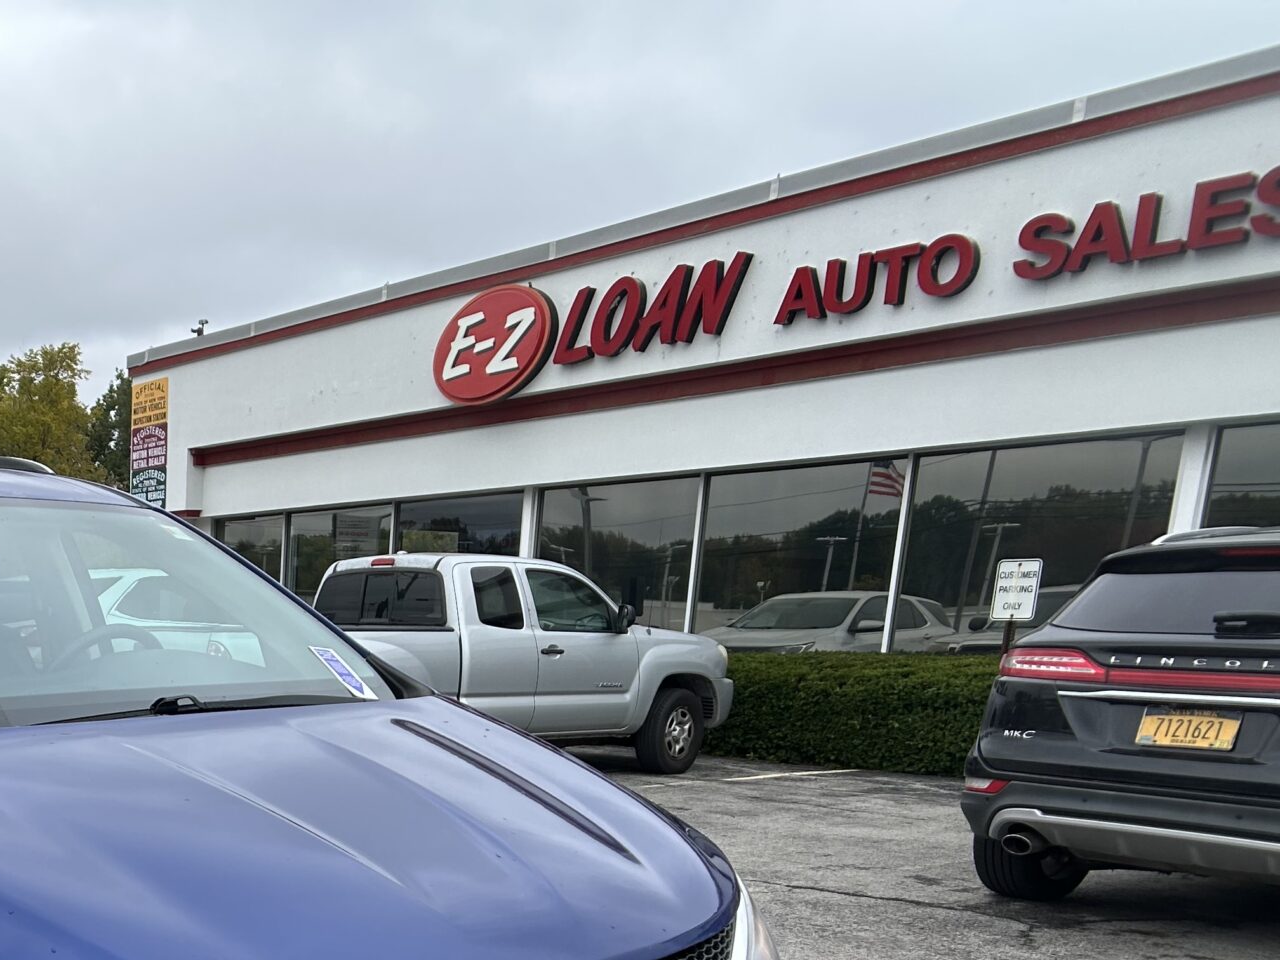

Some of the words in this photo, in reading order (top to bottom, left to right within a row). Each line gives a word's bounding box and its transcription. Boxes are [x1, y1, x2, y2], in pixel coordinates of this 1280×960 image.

[442, 307, 536, 381] E-Z
[552, 250, 753, 366] LOAN
[773, 233, 982, 326] AUTO
[135, 382, 165, 399] OFFICIAL
[148, 400, 167, 412] VEHICLE
[133, 425, 166, 445] REGISTERED
[148, 455, 165, 467] DEALER
[132, 469, 166, 486] REGISTERED
[999, 571, 1038, 580] CUSOMER
[998, 585, 1034, 593] PARKING
[1002, 602, 1023, 610] ONLY
[1003, 729, 1037, 739] MKC
[1153, 717, 1224, 740] 7121621
